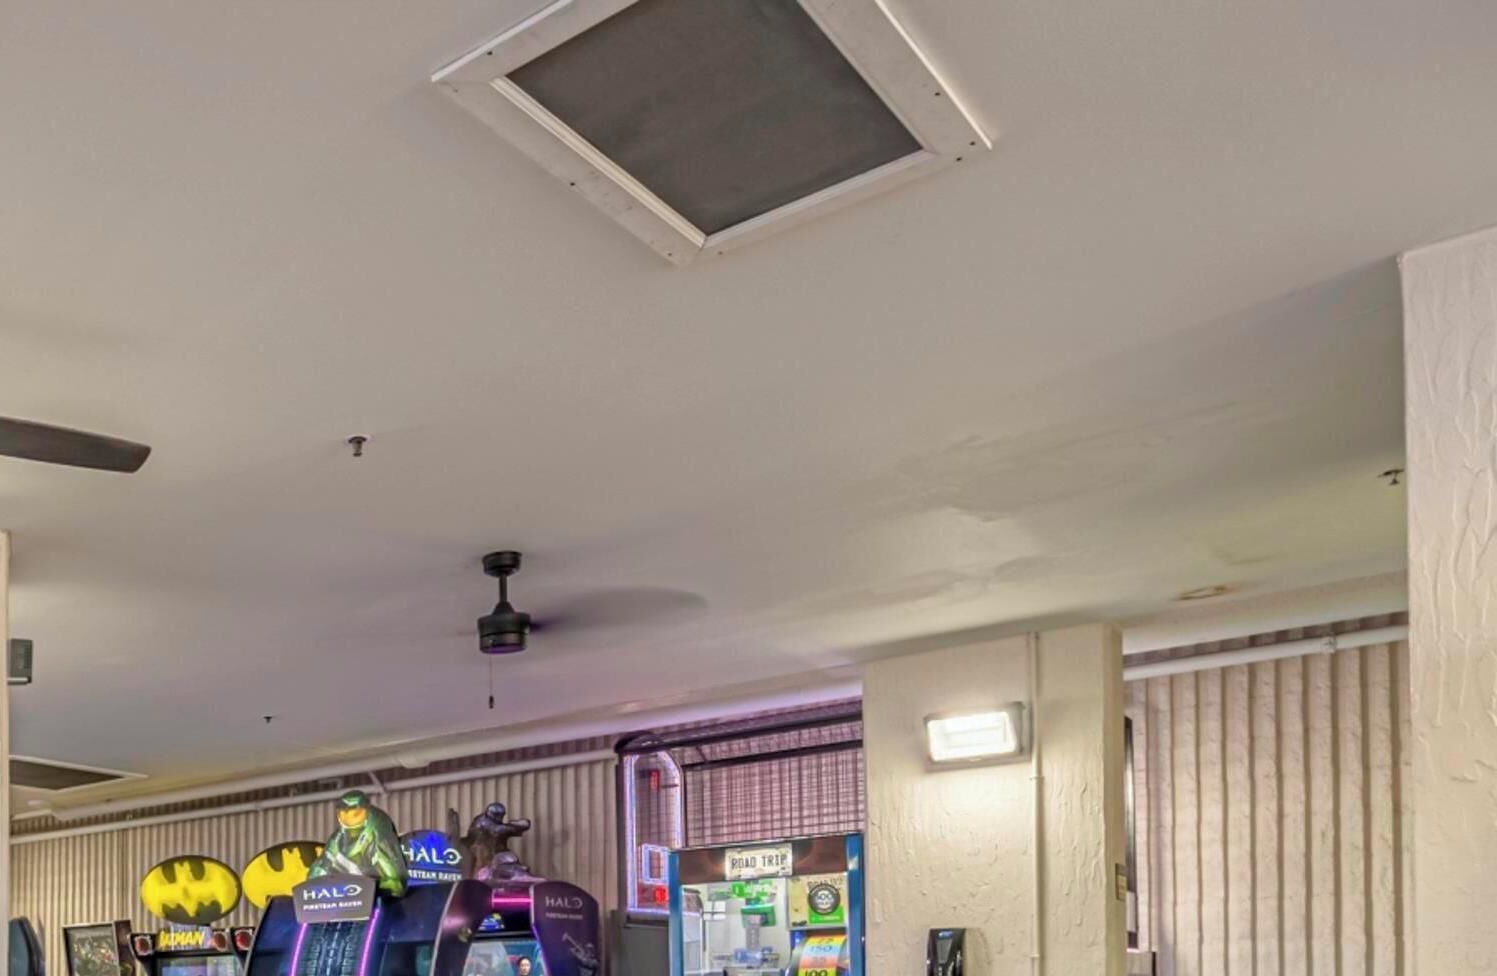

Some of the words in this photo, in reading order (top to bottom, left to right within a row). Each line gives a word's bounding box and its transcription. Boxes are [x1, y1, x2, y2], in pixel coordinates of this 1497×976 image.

[401, 844, 462, 864] HALO
[731, 857, 757, 869] ROAD
[762, 854, 787, 868] TRIP
[303, 884, 362, 901] HALO
[545, 895, 583, 908] HALO
